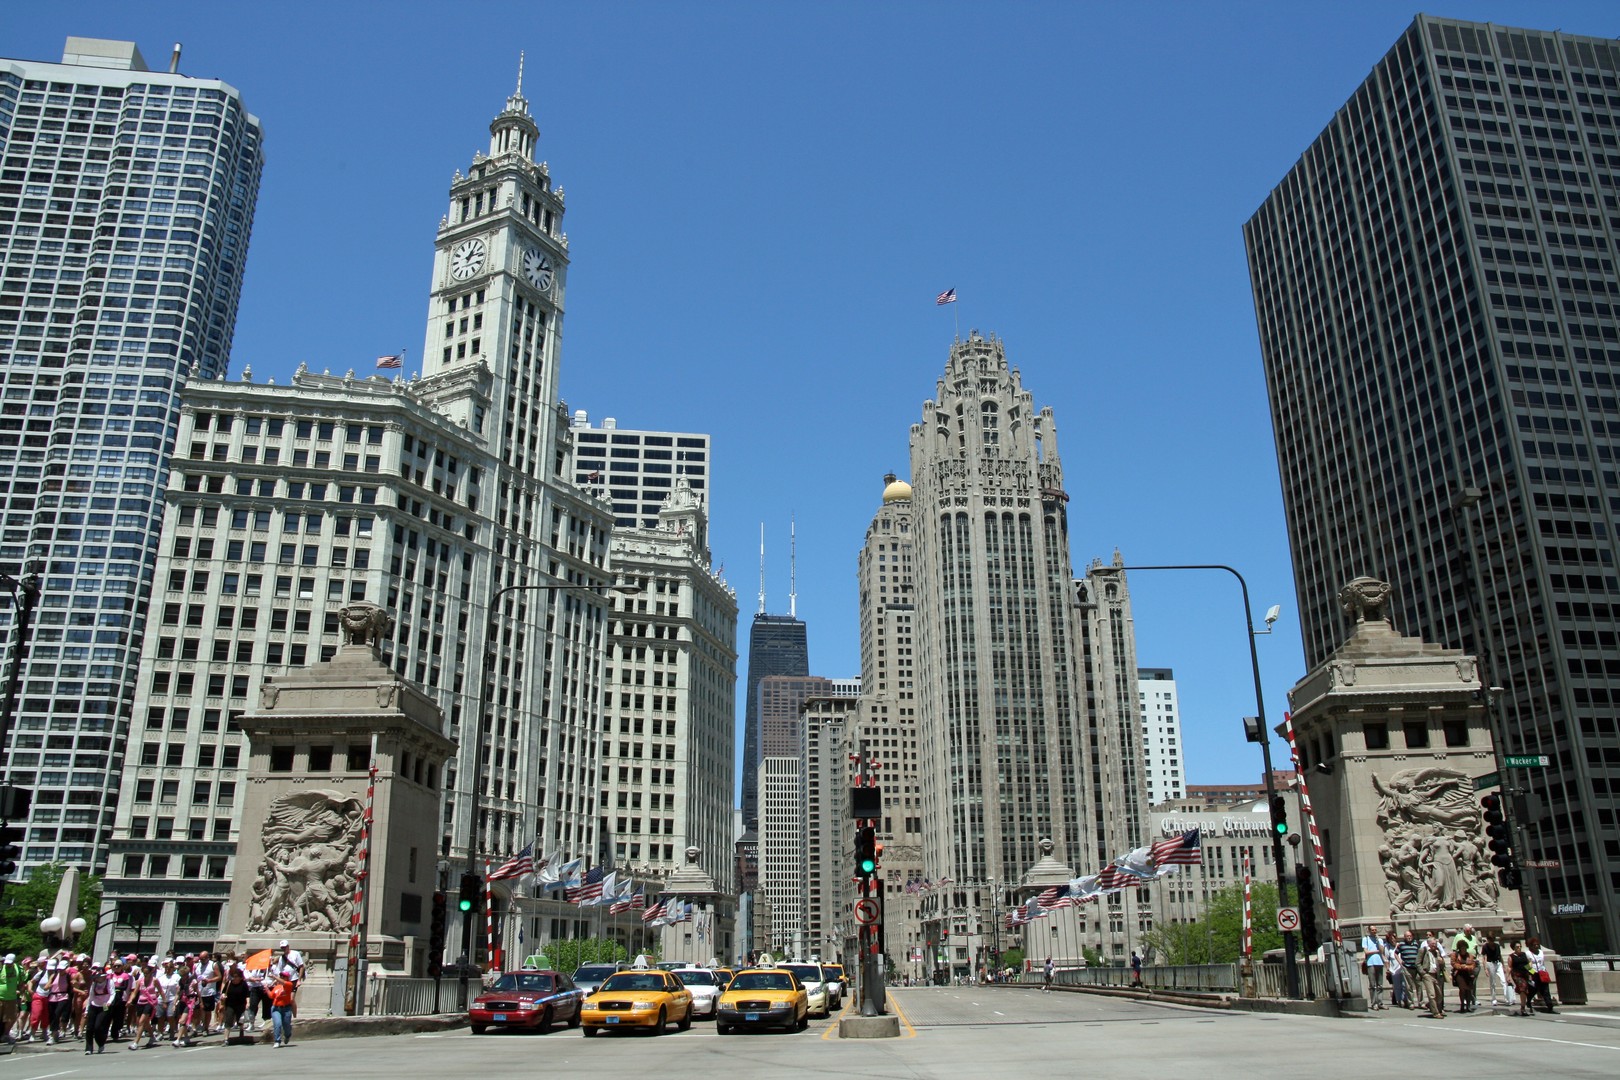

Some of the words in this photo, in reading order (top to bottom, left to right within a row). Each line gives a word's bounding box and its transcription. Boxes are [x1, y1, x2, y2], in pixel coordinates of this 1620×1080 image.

[1511, 757, 1532, 765] Wacker
[1160, 816, 1216, 834] Chicago
[1558, 903, 1585, 913] Fidelity
